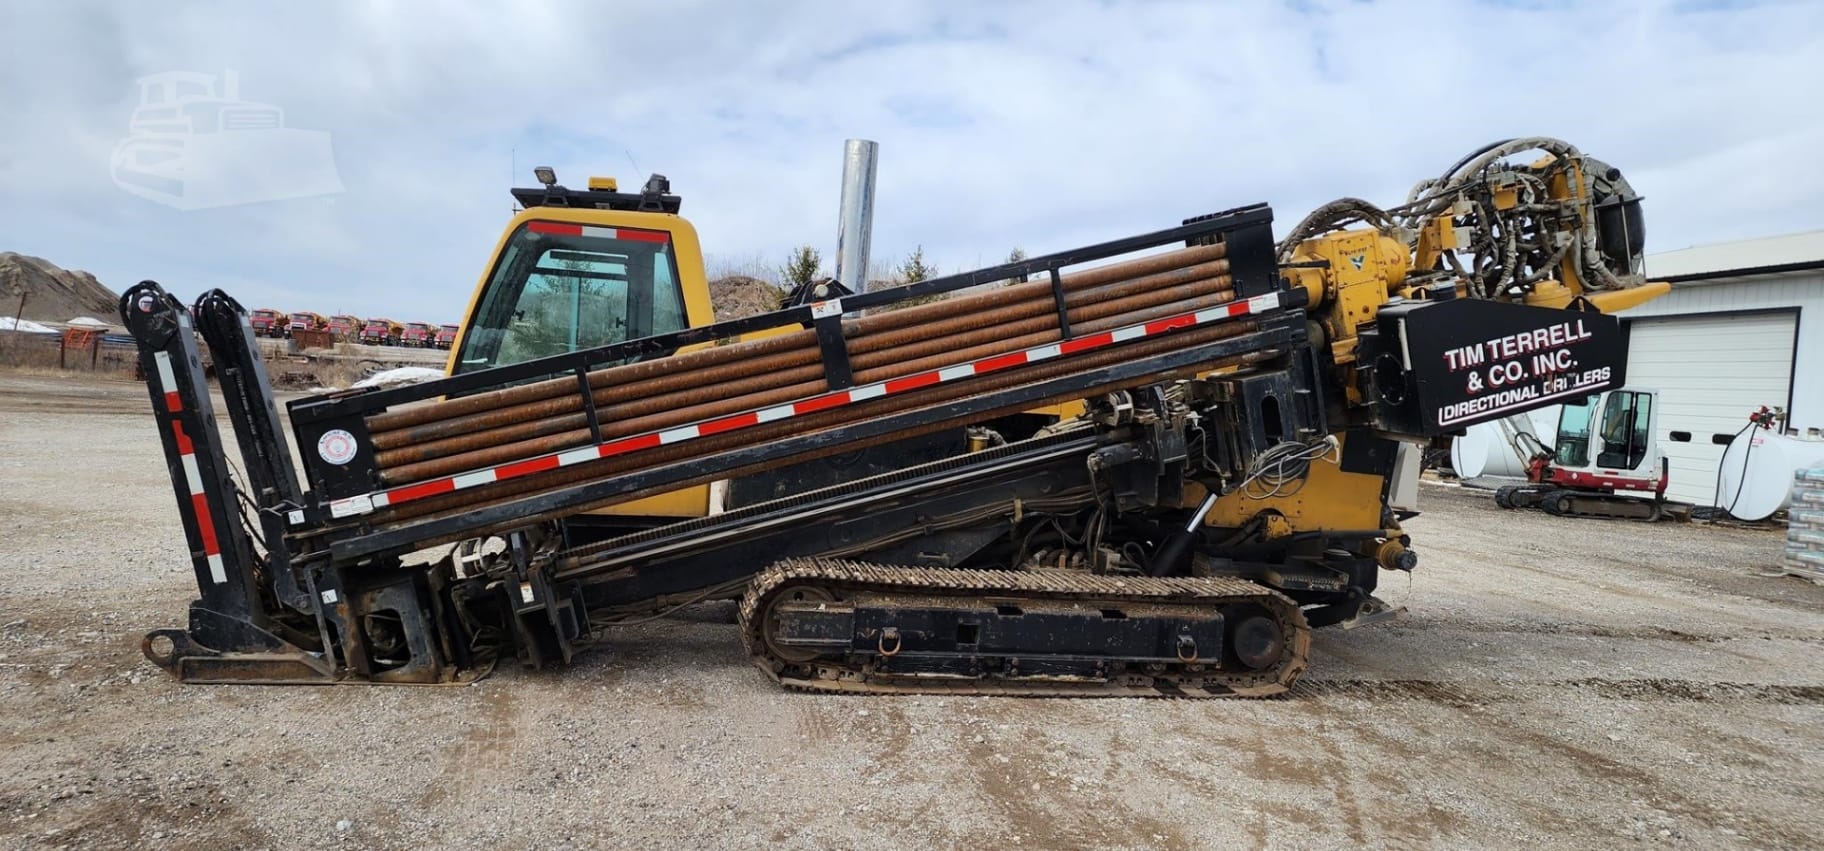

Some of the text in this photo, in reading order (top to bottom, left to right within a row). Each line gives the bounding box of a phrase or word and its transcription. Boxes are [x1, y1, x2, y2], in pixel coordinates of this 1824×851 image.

[1443, 318, 1592, 371] TIM TERRELL
[1466, 348, 1578, 393] & CO. INC.
[1444, 366, 1611, 420] DIRECTIONAL DRILERS
